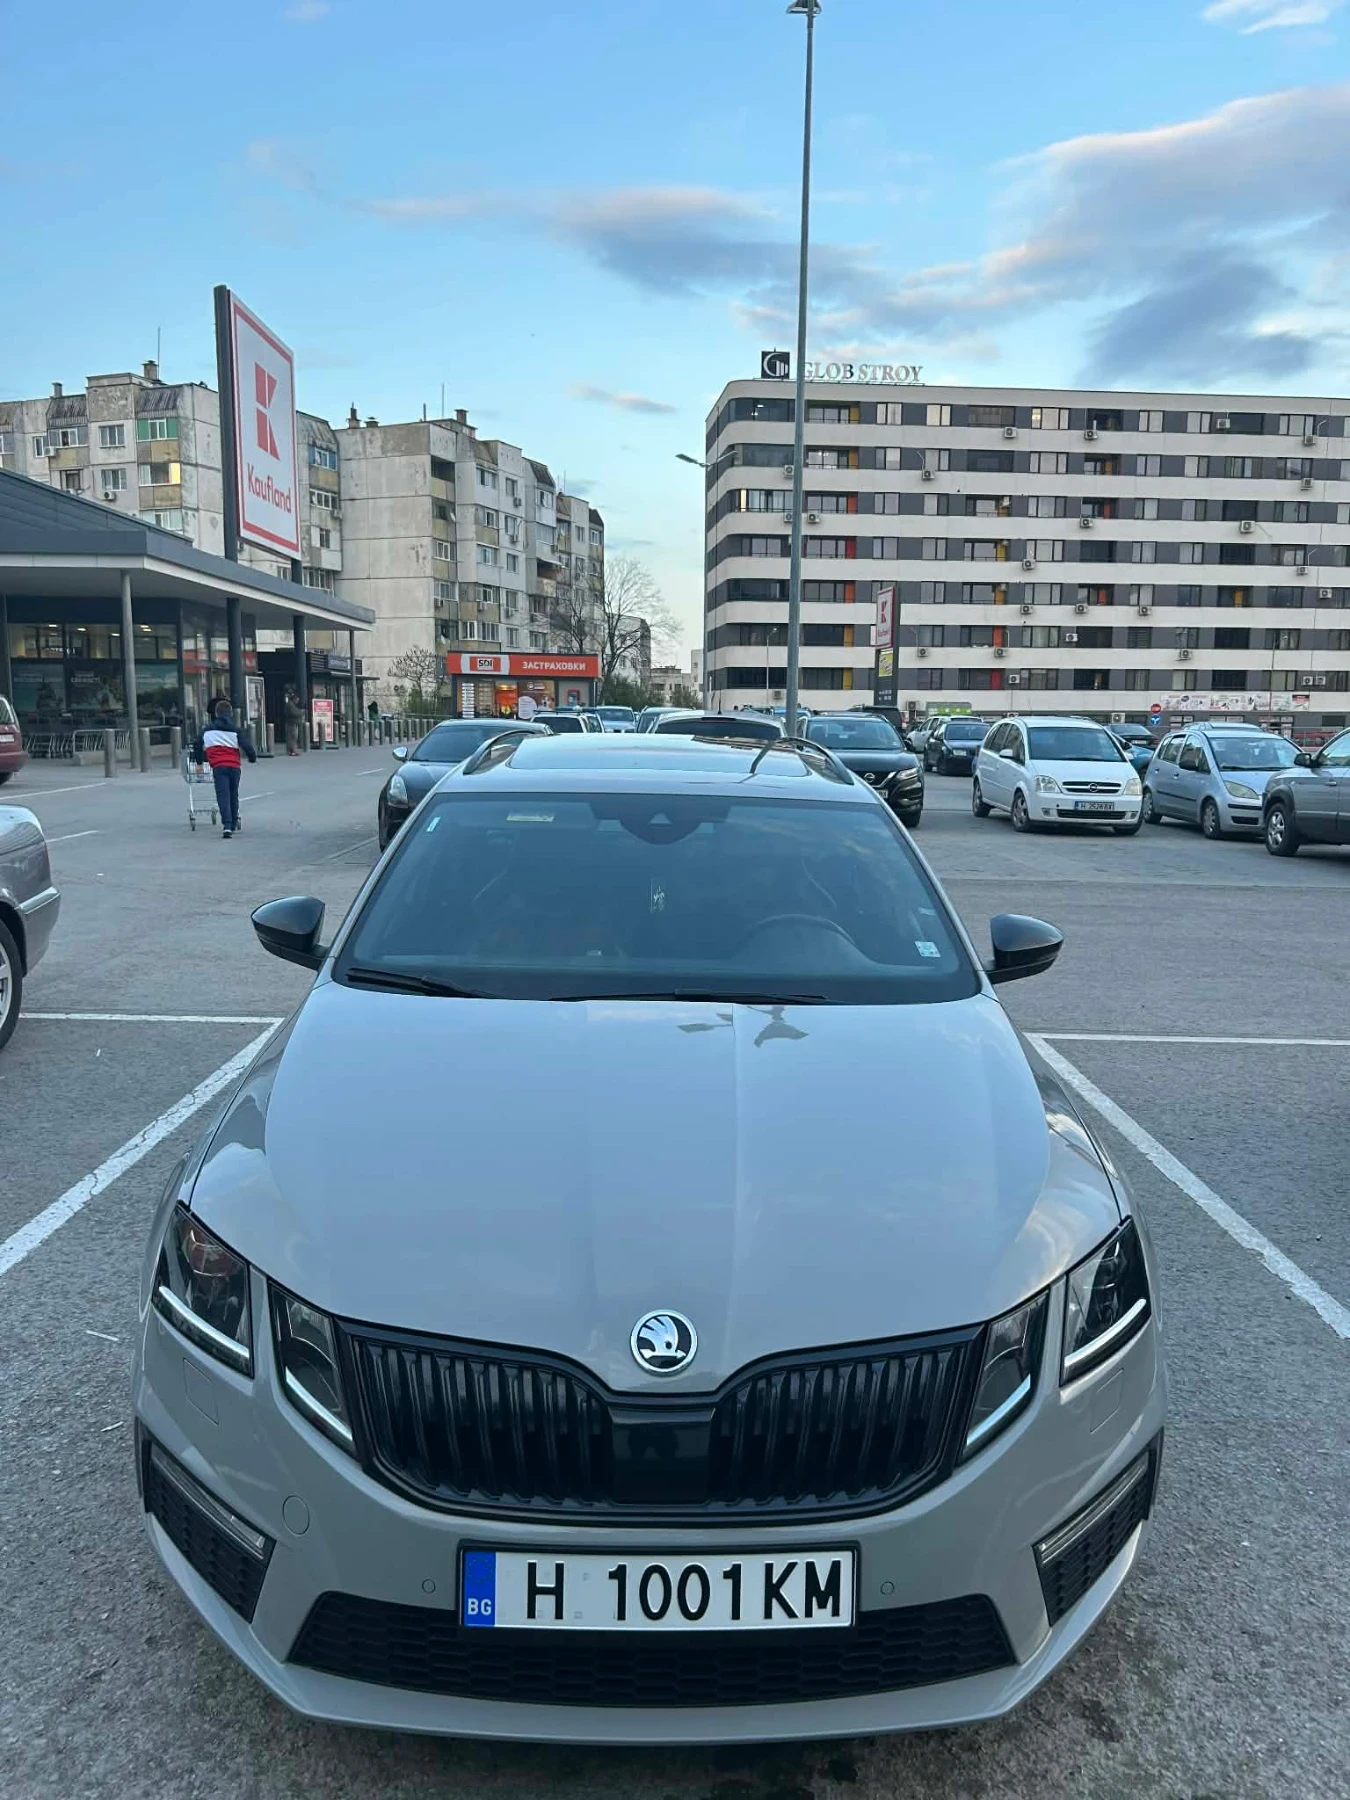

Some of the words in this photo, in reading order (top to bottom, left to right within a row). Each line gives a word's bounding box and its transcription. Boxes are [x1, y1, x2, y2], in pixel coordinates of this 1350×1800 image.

[858, 363, 923, 382] STROY
[247, 462, 292, 514] Kaufland
[478, 659, 493, 667] SDI
[522, 661, 586, 671] ЗАСТРАХОВКИ
[526, 1561, 565, 1620] H
[467, 1598, 492, 1616] BG
